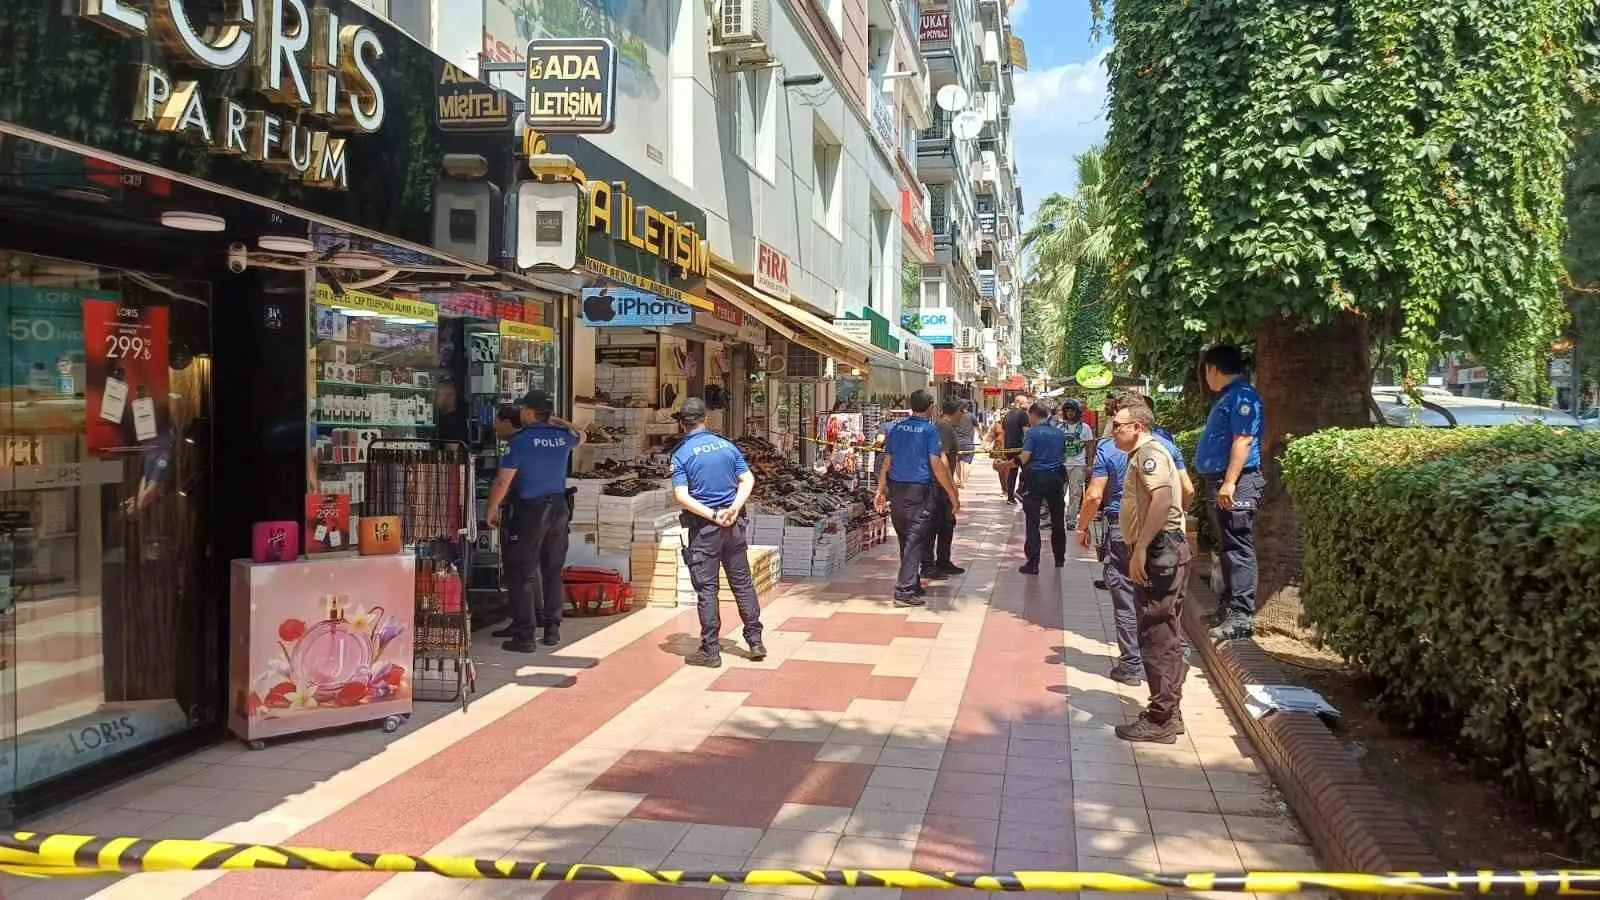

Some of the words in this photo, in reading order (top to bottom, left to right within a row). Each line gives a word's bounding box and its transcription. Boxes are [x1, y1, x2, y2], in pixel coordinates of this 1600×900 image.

[543, 55, 601, 80] ADA
[530, 86, 603, 121] İLETİŞİM
[146, 66, 348, 188] PARFUM
[612, 181, 710, 280] İLETİŞİM
[618, 297, 690, 316] iPhone
[105, 335, 143, 359] 299
[67, 716, 135, 754] LORIS
